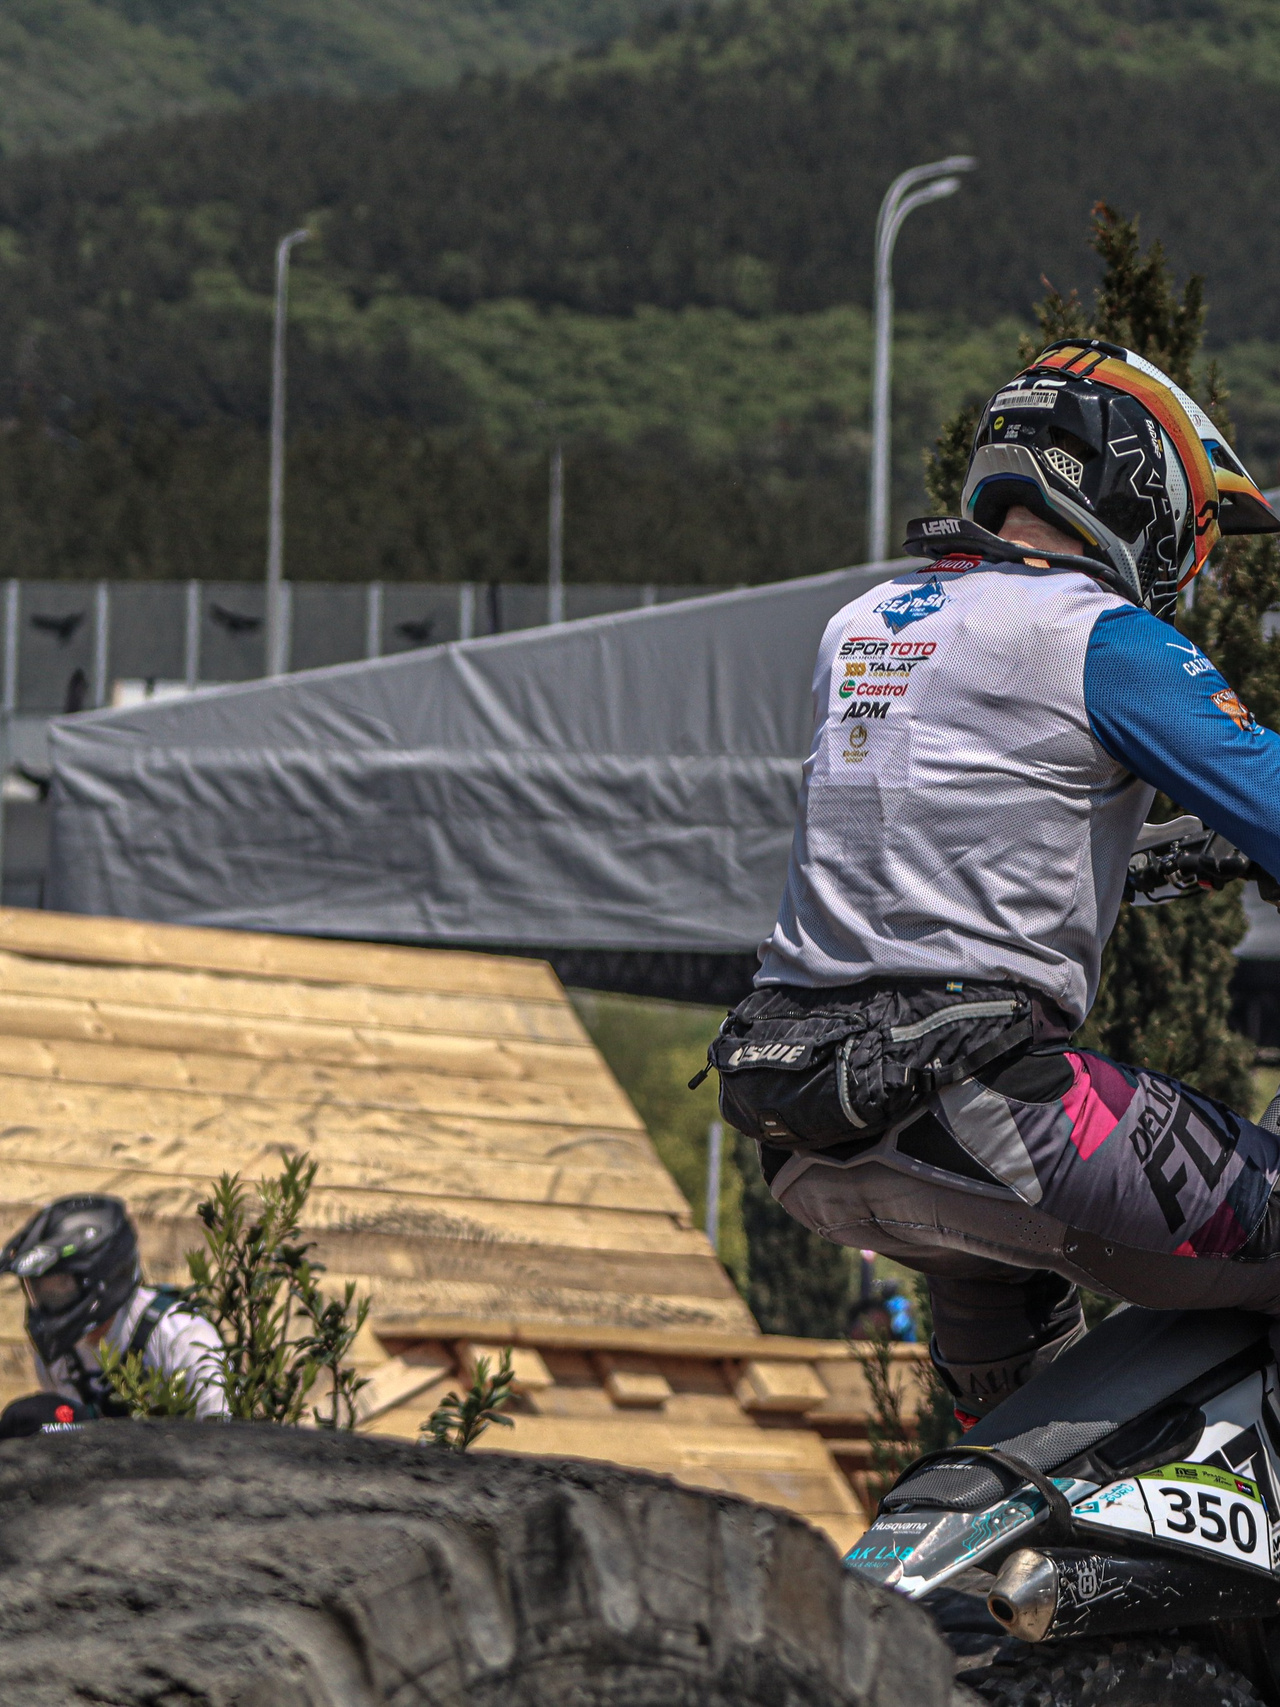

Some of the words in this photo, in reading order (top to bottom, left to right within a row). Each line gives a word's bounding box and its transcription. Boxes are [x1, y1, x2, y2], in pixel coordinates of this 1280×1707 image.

[922, 519, 961, 536] LEATT
[876, 600, 911, 614] SEA
[869, 662, 918, 672] TALAY
[856, 683, 909, 697] Castrol
[841, 702, 892, 723] ADM
[1106, 1485, 1136, 1503] GURU
[871, 1522, 928, 1532] Husqvarna
[1158, 1486, 1258, 1554] 350
[845, 1547, 876, 1561] AK
[875, 1546, 916, 1561] LAB
